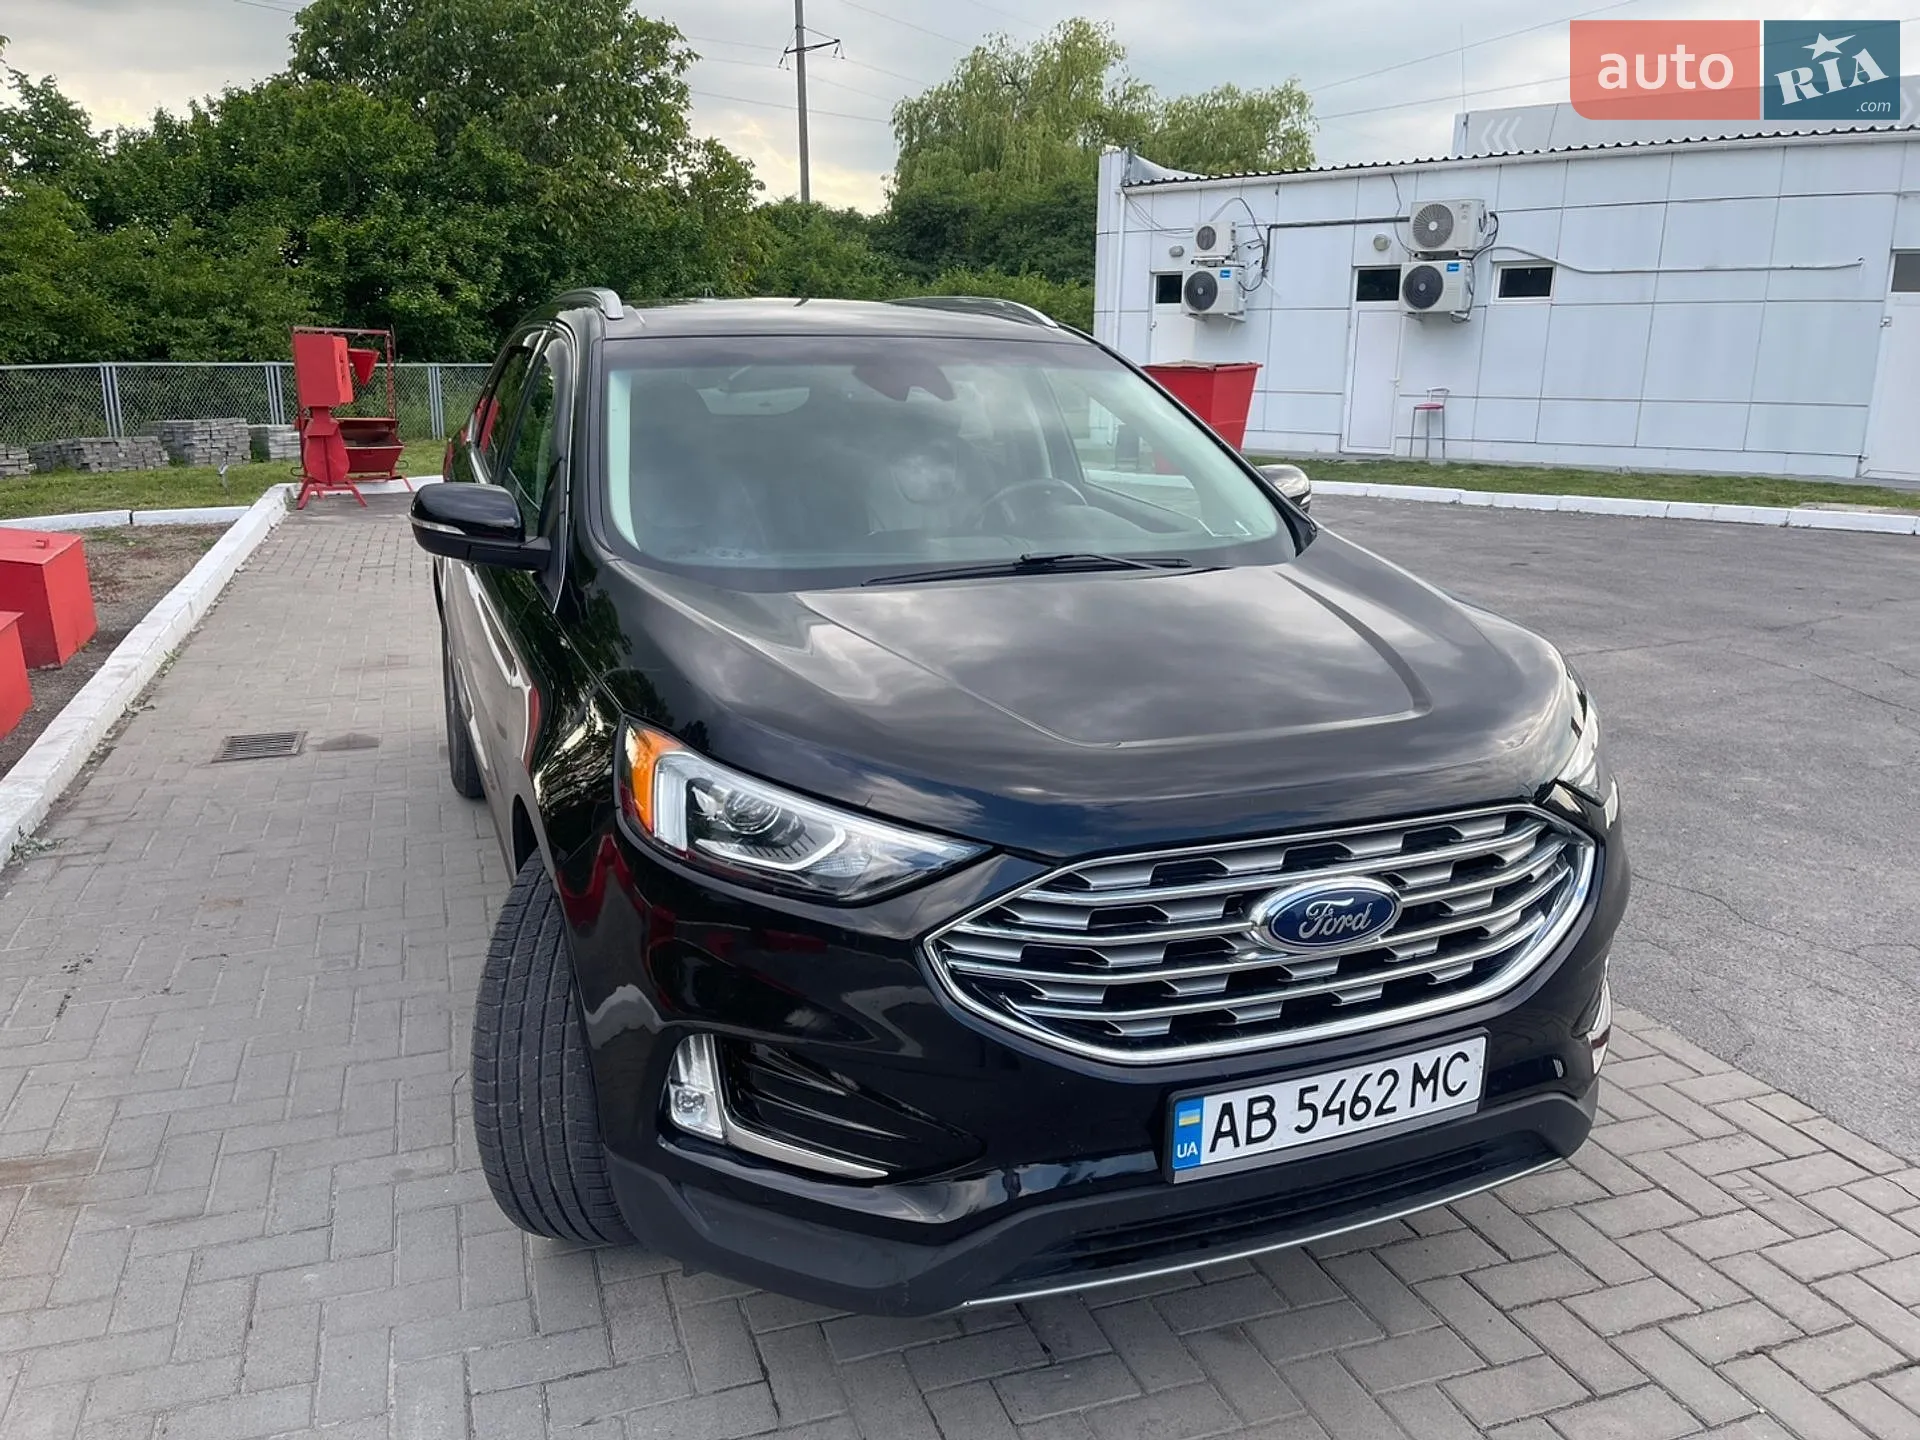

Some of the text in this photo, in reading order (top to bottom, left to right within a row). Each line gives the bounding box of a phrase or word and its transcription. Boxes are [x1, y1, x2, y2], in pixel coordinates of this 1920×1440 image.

[1299, 897, 1373, 939] Ford
[1209, 1051, 1470, 1153] AB 5462 MC
[1176, 1141, 1199, 1159] UA
